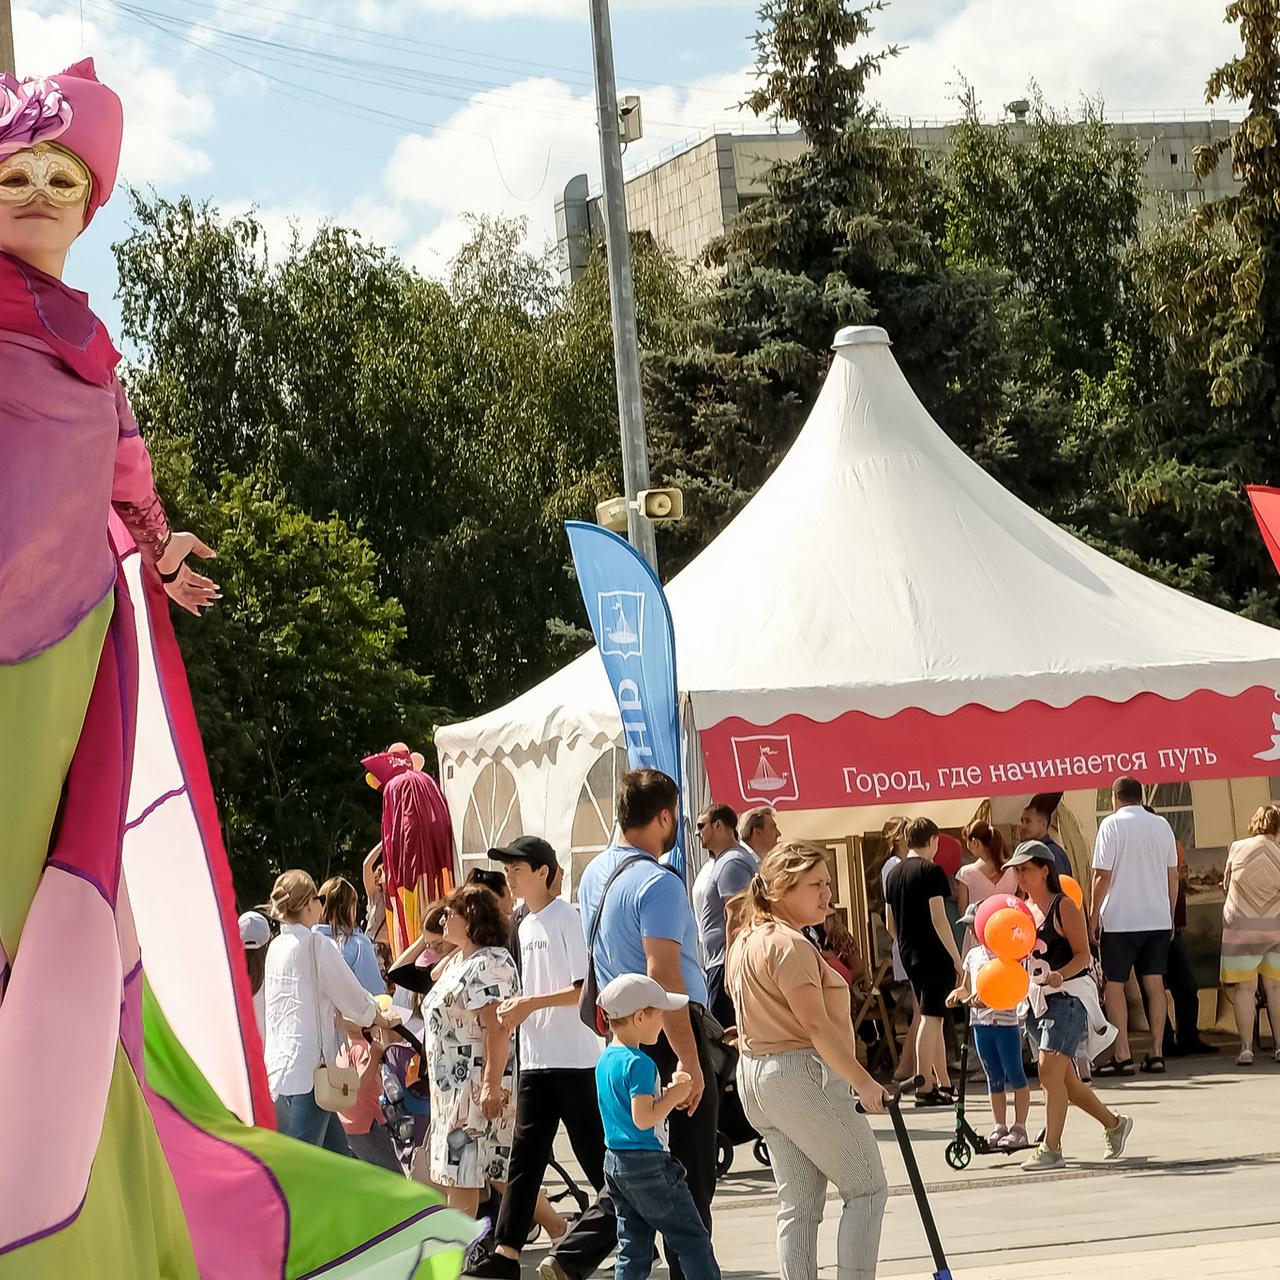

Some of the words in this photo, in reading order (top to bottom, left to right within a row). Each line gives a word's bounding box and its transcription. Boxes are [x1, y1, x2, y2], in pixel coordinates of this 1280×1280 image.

[842, 766, 930, 798] Город,
[937, 765, 982, 789] где
[989, 751, 1148, 783] начинается
[1158, 746, 1218, 774] путь
